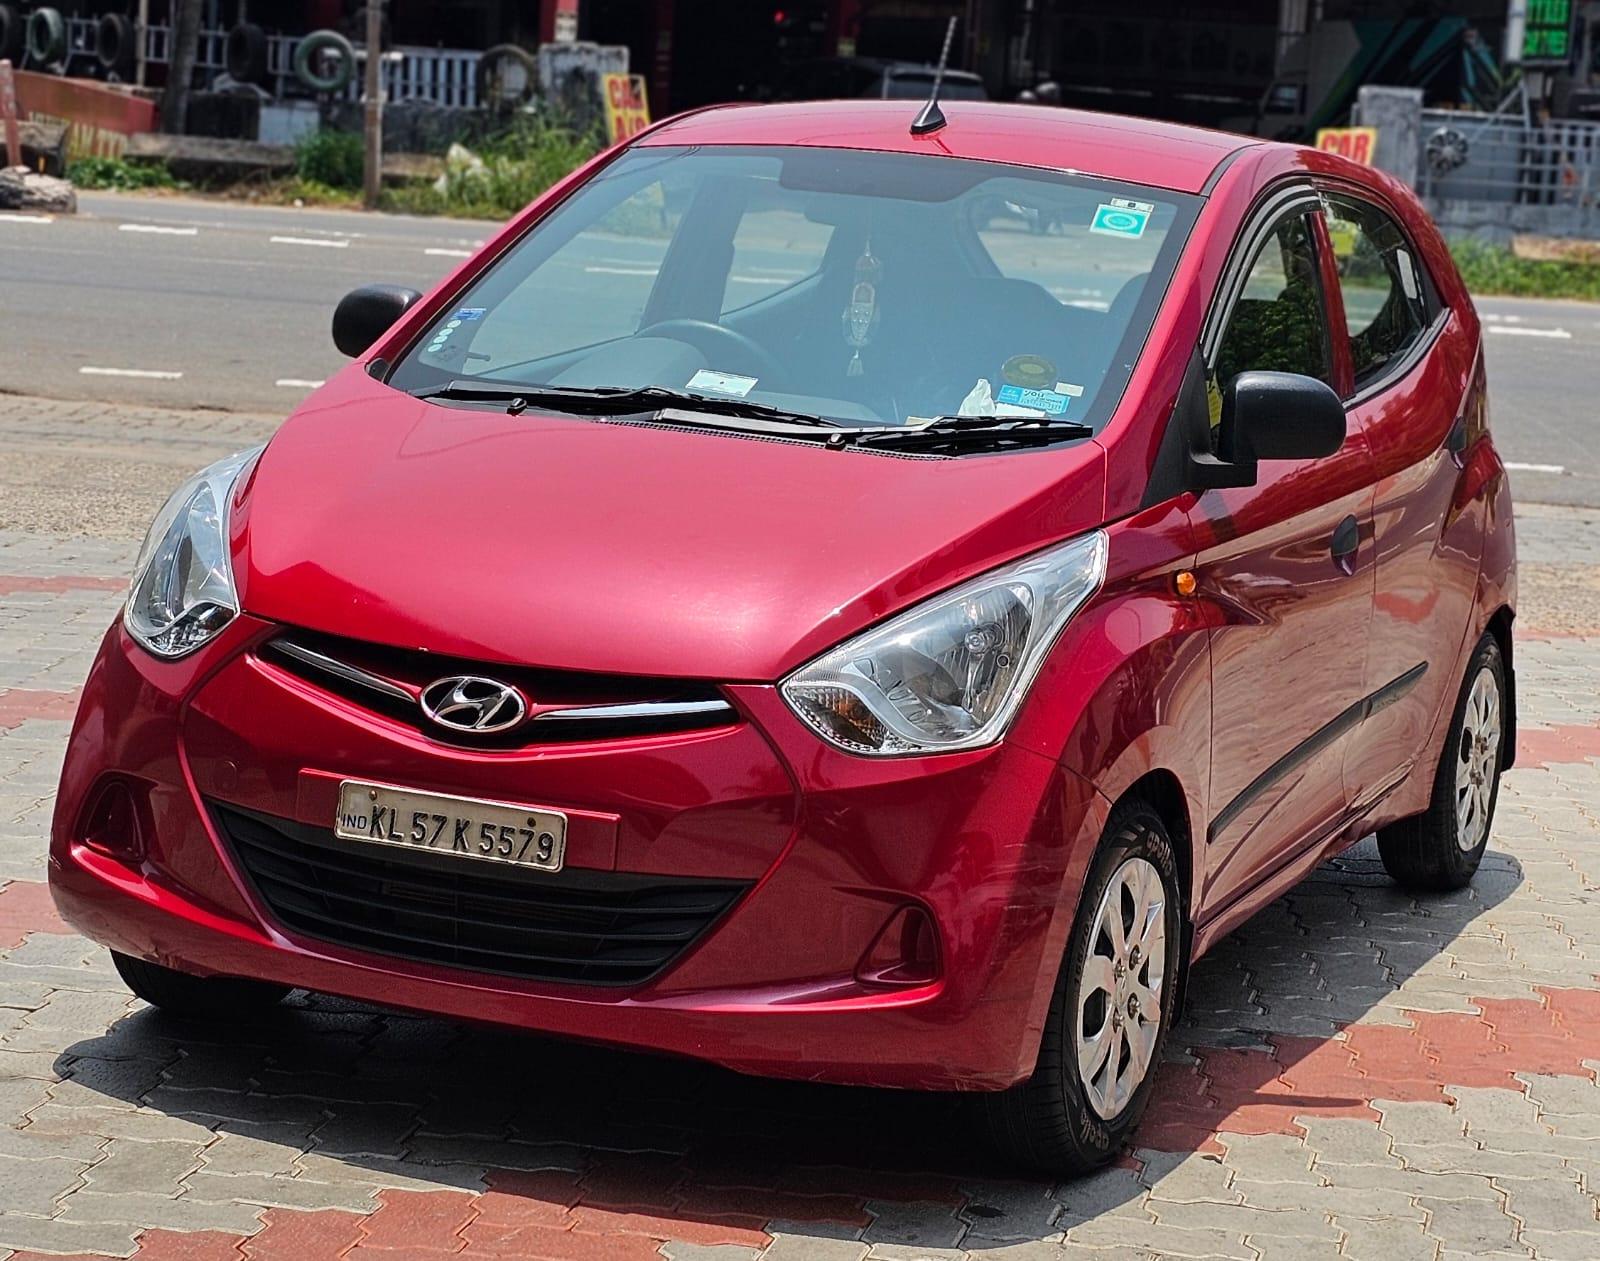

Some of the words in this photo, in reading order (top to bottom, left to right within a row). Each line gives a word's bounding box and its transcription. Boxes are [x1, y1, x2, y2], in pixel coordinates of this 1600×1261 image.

[1322, 133, 1369, 163] CAR
[341, 812, 367, 830] IND
[369, 804, 404, 840] KL
[411, 811, 447, 847] 57
[454, 817, 471, 850] K
[479, 822, 554, 862] 5579
[1147, 831, 1173, 877] apollo
